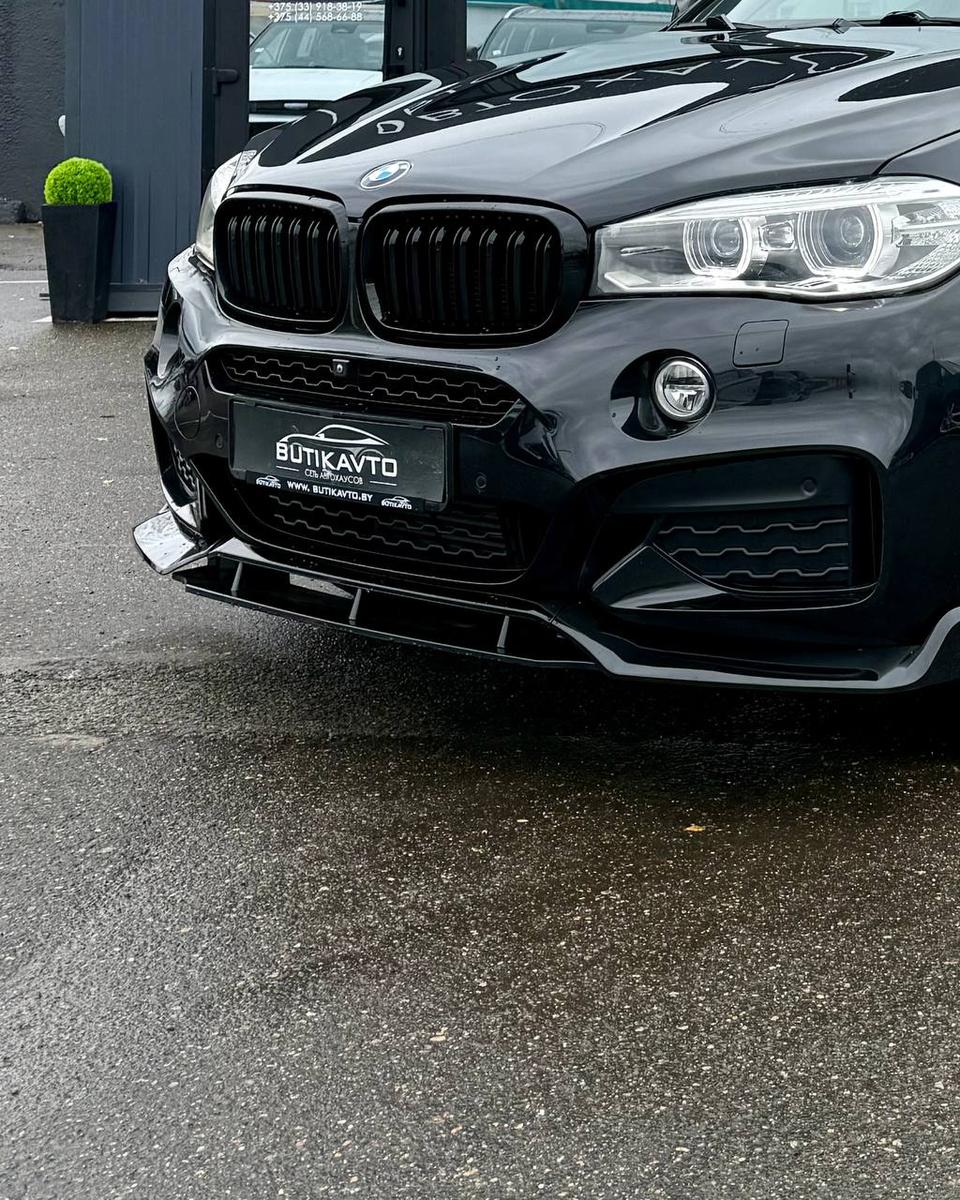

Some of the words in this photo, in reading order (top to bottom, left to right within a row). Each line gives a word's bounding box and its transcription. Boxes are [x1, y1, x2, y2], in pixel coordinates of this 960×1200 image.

[268, 2, 292, 12] +375
[294, 1, 313, 13] (33)
[268, 12, 292, 23] +375
[294, 12, 313, 23] (44)
[315, 12, 363, 22] 568-66-88
[276, 441, 398, 477] BUTIKAVTO
[304, 468, 319, 479] СЕТЬ
[286, 480, 310, 493] WWW.
[312, 484, 374, 502] BUTIKAVTO.BY
